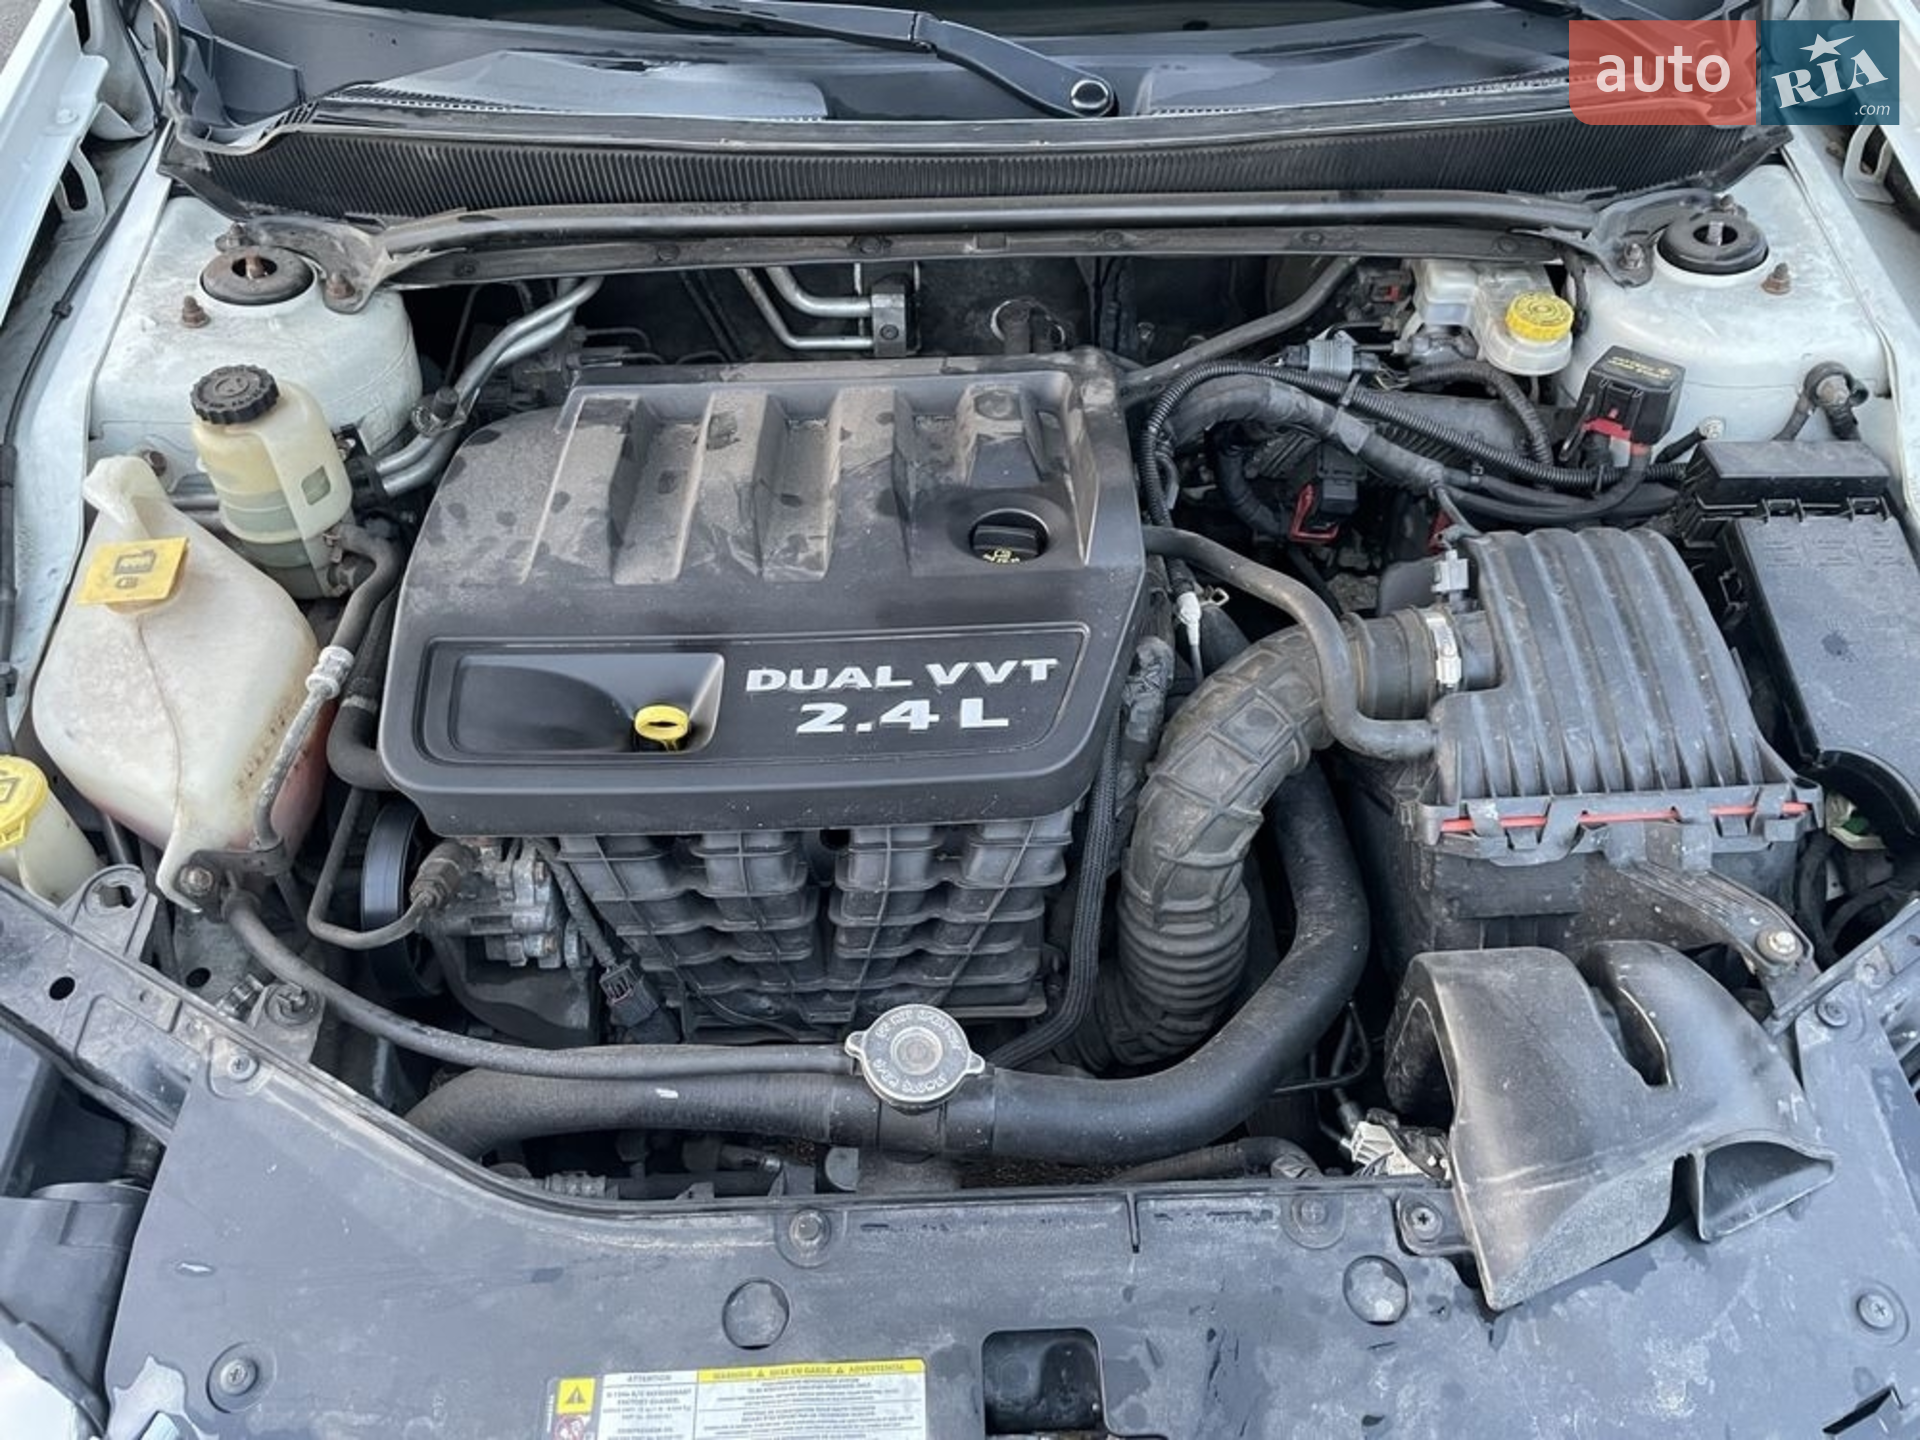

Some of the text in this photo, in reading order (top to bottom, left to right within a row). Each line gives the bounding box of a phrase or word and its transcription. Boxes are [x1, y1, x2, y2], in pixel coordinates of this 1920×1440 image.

[746, 658, 1059, 692] DUAL VVT
[796, 698, 1009, 734] 2.4 L
